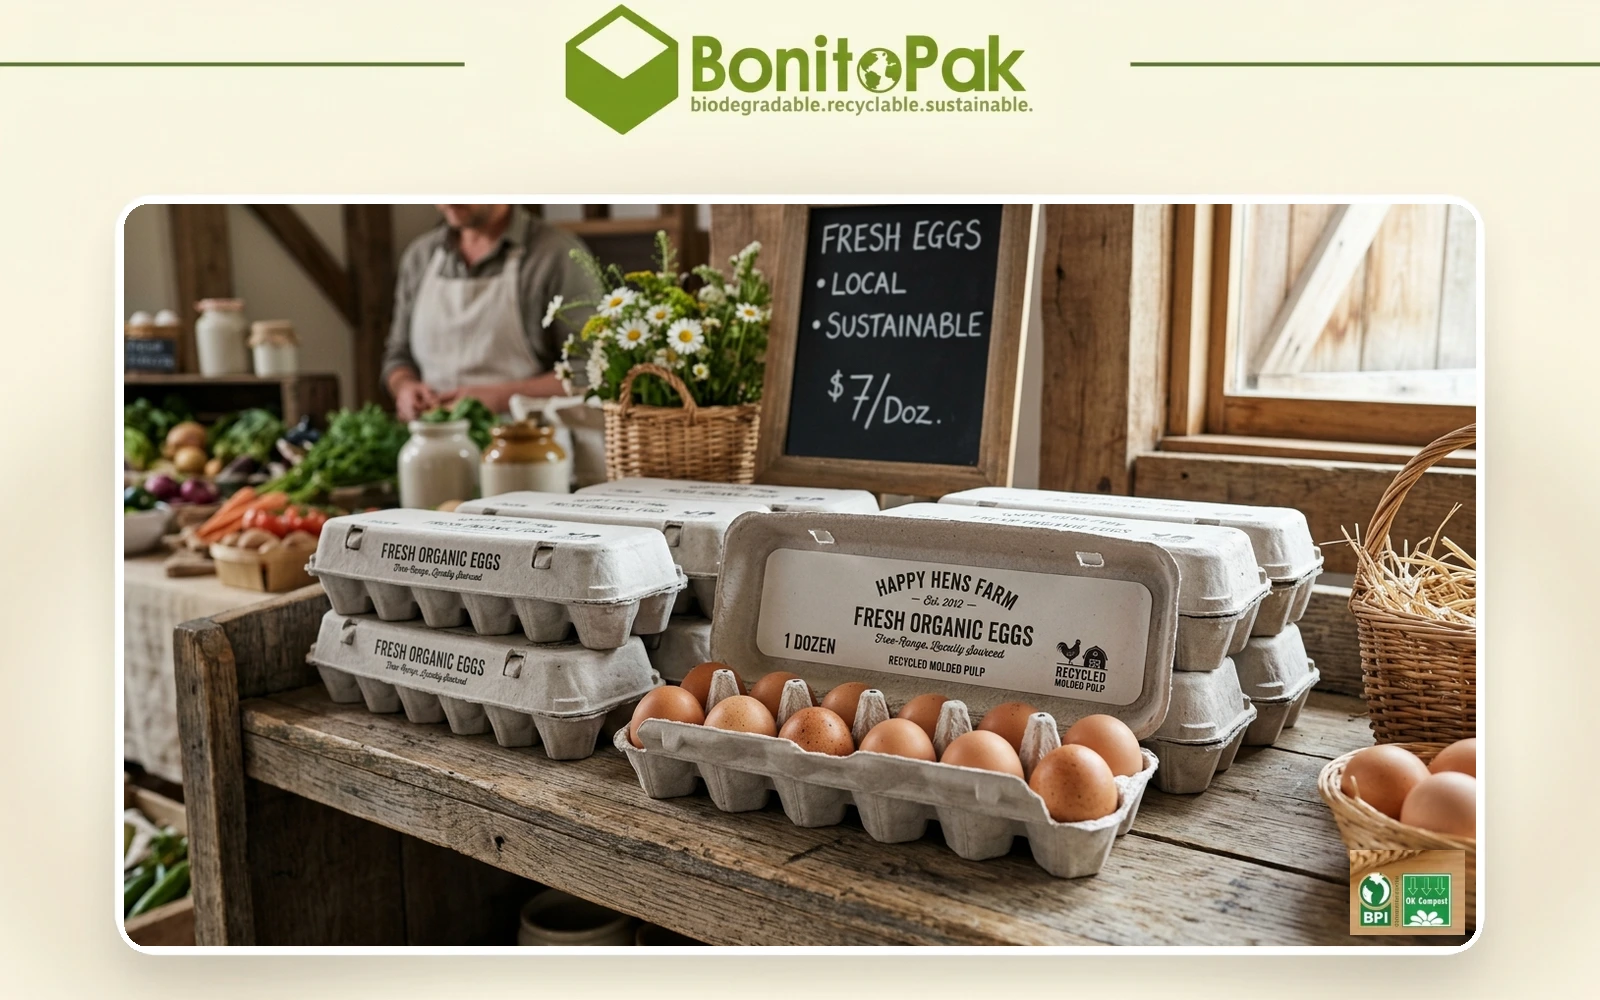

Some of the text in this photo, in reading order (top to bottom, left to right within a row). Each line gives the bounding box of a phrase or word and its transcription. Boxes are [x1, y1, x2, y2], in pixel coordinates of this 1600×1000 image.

[821, 219, 982, 254] FRESH EGGS
[831, 272, 906, 296] LOCAL
[825, 311, 984, 340] SUSTAINABLE
[380, 542, 501, 570] FRESH ORGANIC EGGS
[876, 571, 1019, 611] HAPPY HENS FARM
[942, 598, 964, 608] 2012
[854, 606, 1034, 646] FRESH ORGANIC EGGS
[784, 632, 836, 655] 1 DOZEN
[965, 644, 1006, 659] Sourced
[374, 638, 408, 660] FRESH
[408, 646, 454, 670] ORGANIC
[456, 655, 486, 676] EGGS
[888, 656, 986, 677] RECYCLED MOLDED PULP
[1056, 666, 1106, 682] RECYCLED
